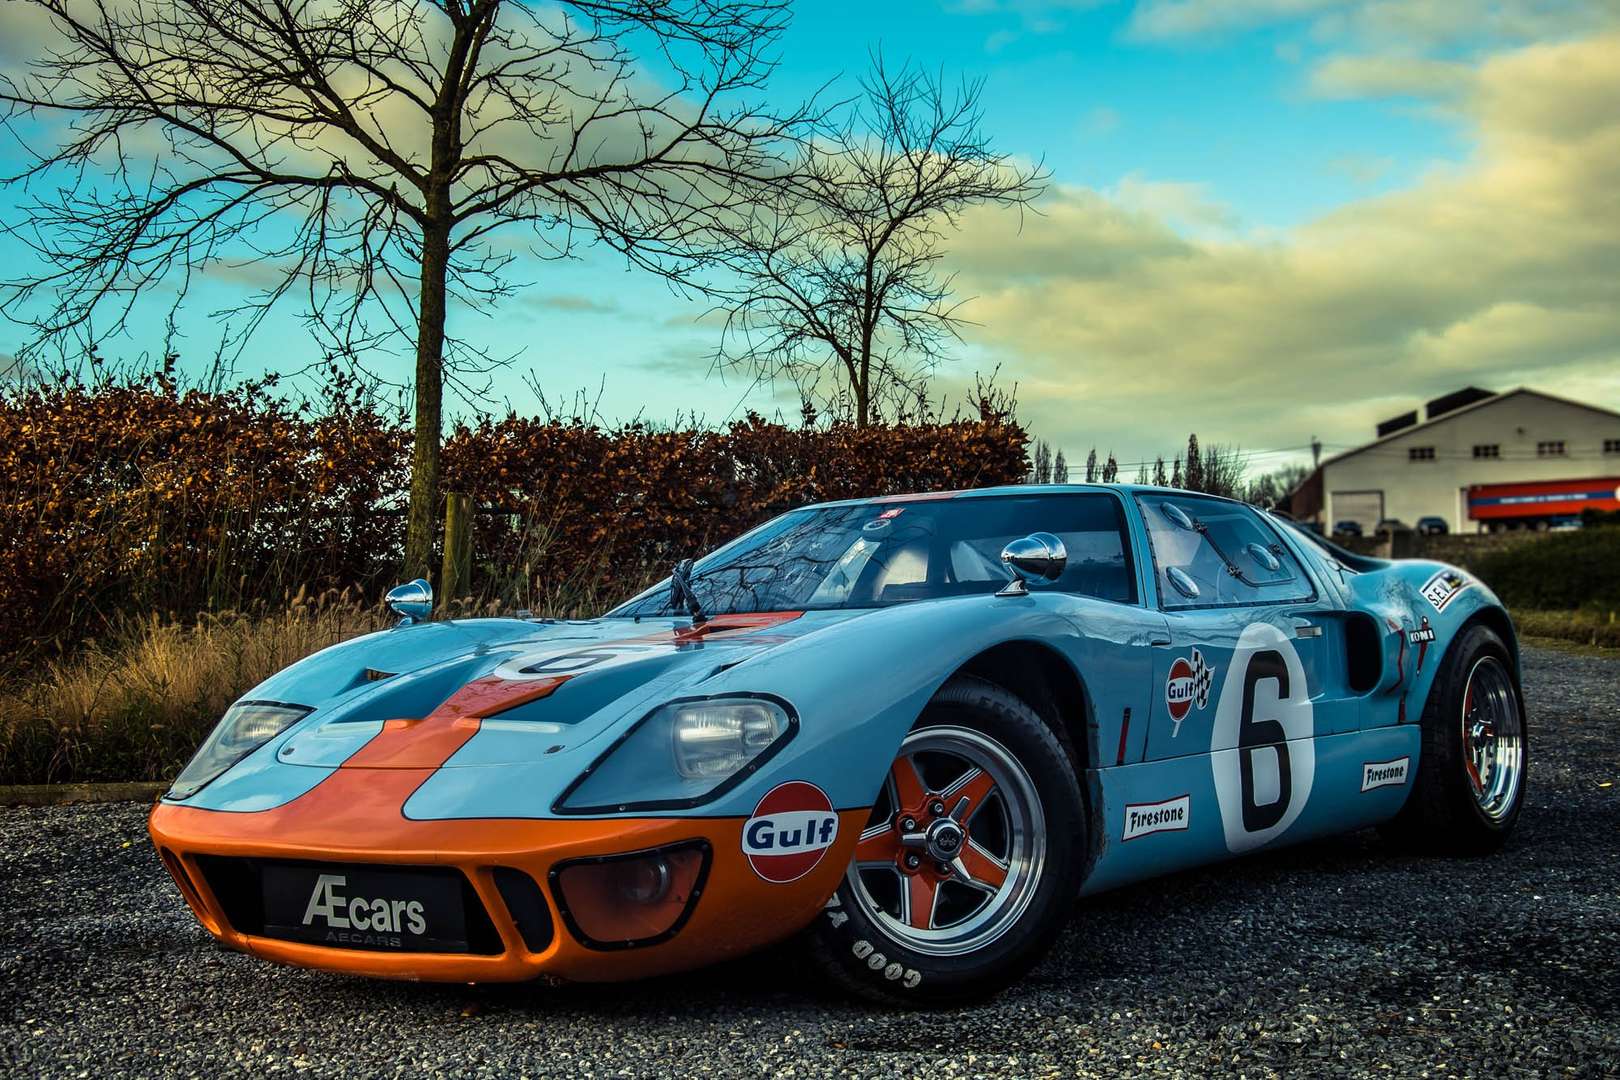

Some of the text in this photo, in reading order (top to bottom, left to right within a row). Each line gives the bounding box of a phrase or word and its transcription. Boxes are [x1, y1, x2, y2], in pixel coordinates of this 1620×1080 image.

[1168, 682, 1194, 699] Gulf
[1239, 650, 1292, 832] 6
[1365, 767, 1404, 786] Firestone
[1130, 807, 1184, 832] Firestone
[747, 818, 835, 849] Gulf
